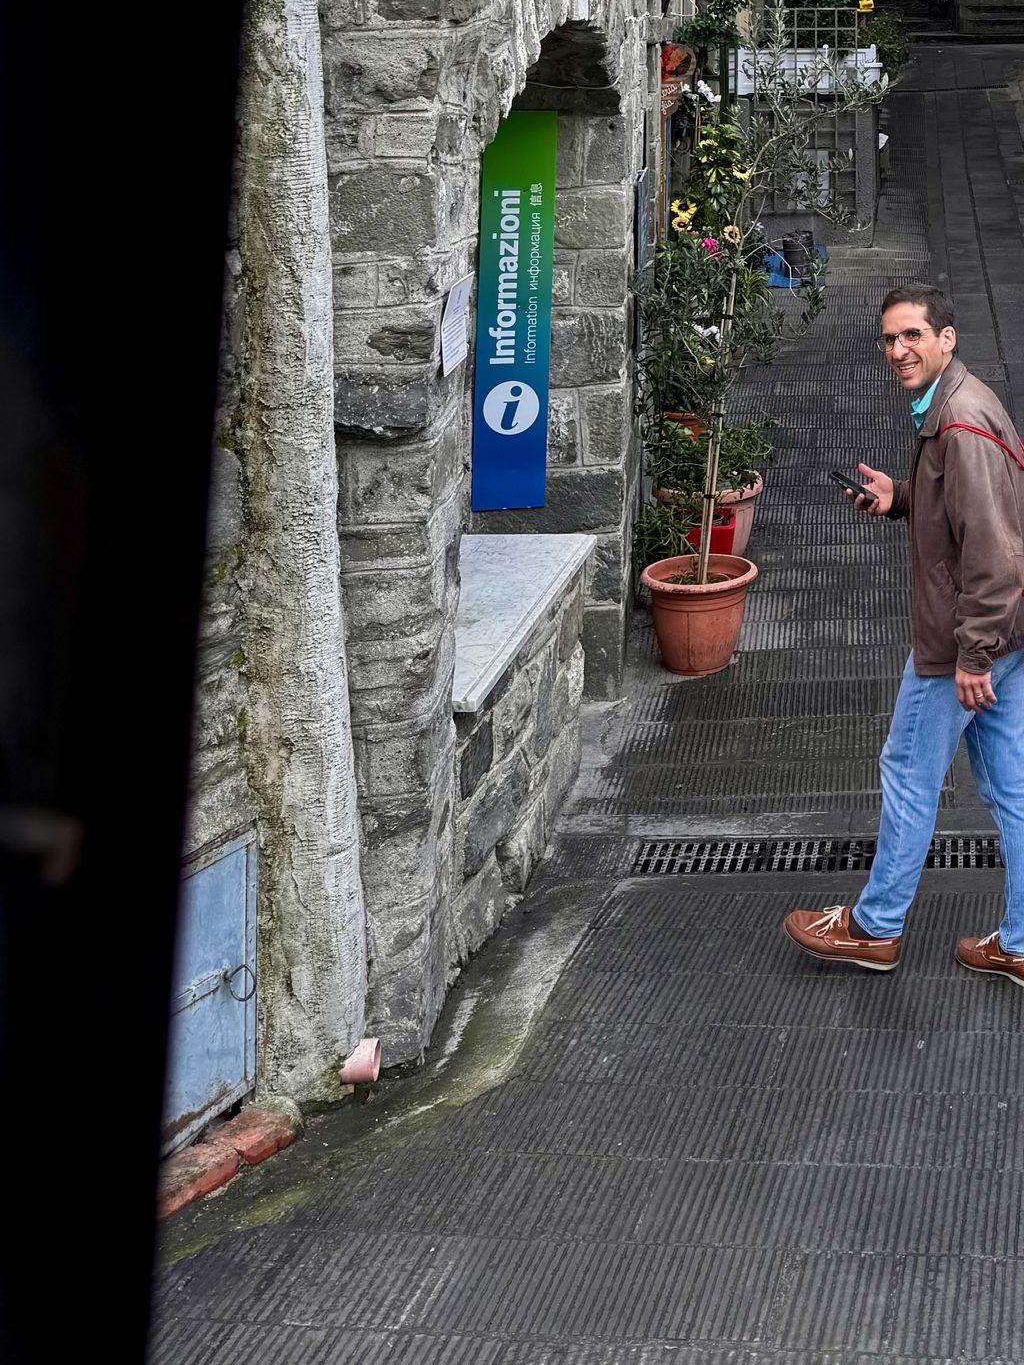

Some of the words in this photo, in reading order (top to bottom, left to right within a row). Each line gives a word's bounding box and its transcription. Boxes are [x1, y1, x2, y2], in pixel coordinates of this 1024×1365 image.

[530, 182, 543, 206] 信息
[489, 188, 521, 365] Informazioni
[529, 211, 542, 290] информация
[524, 295, 538, 365] Information
